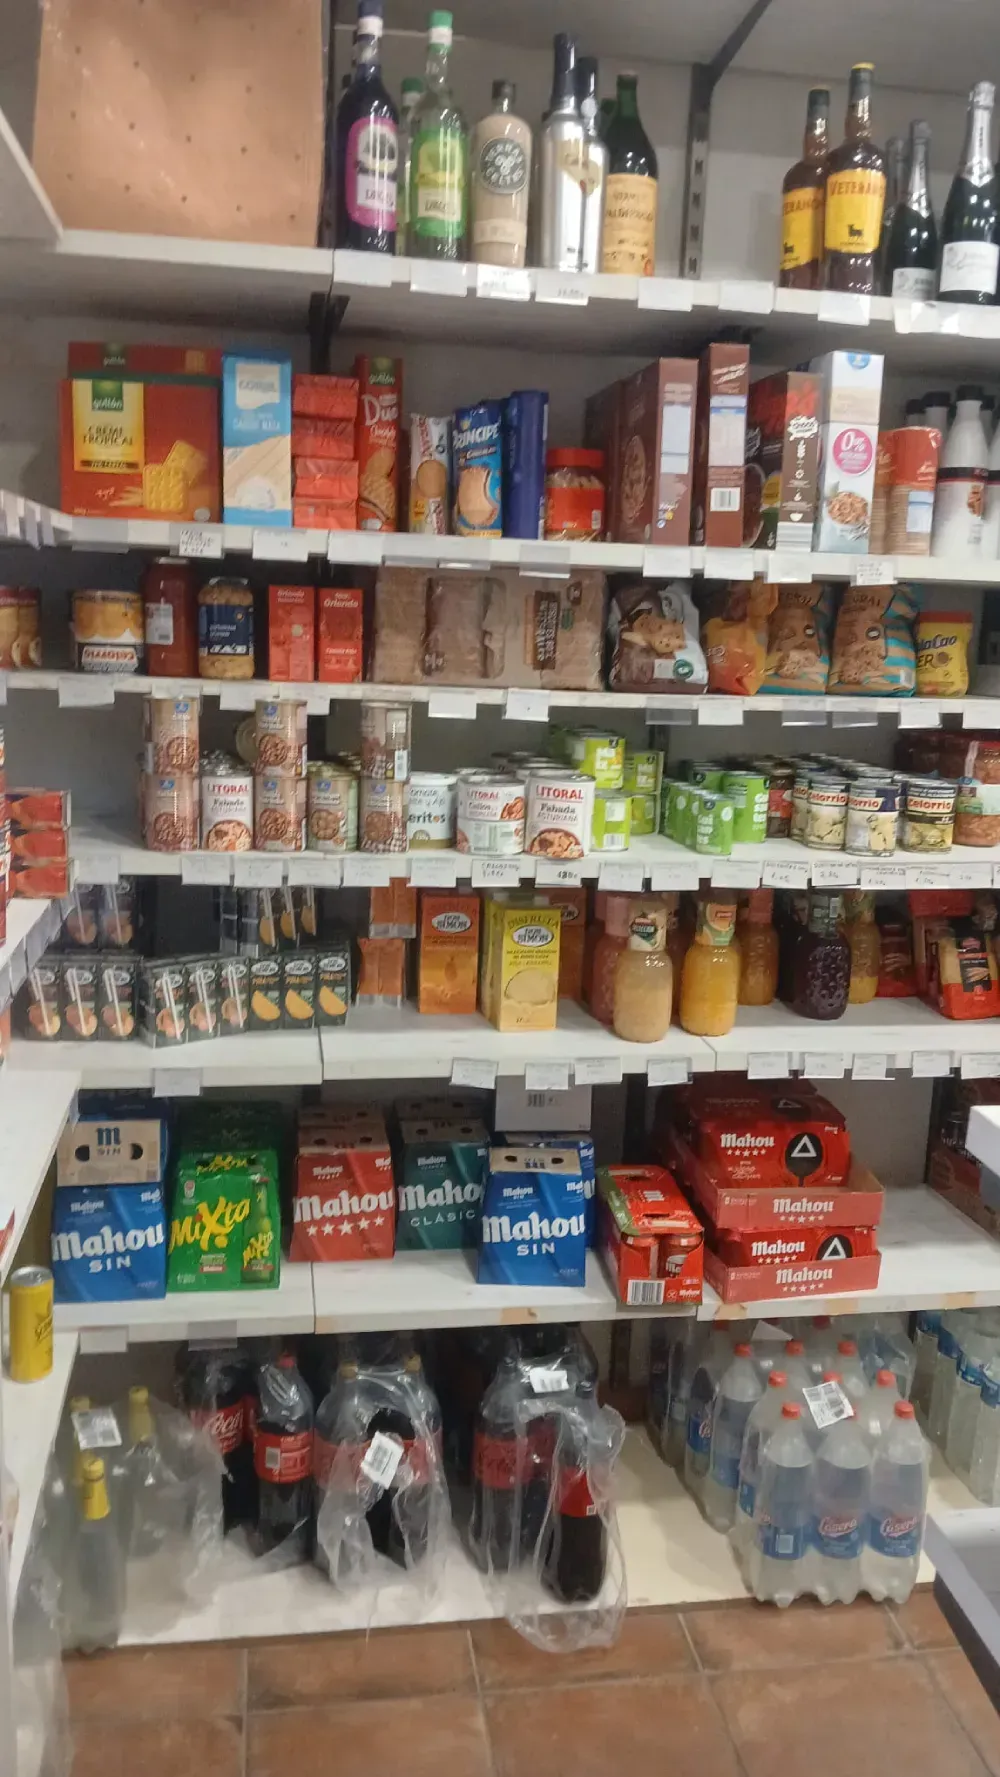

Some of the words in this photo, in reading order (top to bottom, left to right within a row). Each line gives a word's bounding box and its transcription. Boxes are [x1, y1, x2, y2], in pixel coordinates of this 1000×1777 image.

[535, 784, 583, 800] LITORAL
[720, 1132, 775, 1148] Mahou
[293, 1188, 395, 1224] Mahou
[773, 1198, 835, 1214] Mahou
[481, 1211, 586, 1244] Mahou
[51, 1222, 164, 1261] Mahou
[517, 1241, 556, 1257] SIN
[751, 1239, 806, 1257] Mahou
[89, 1255, 131, 1274] SIN
[775, 1266, 834, 1285] Mahou
